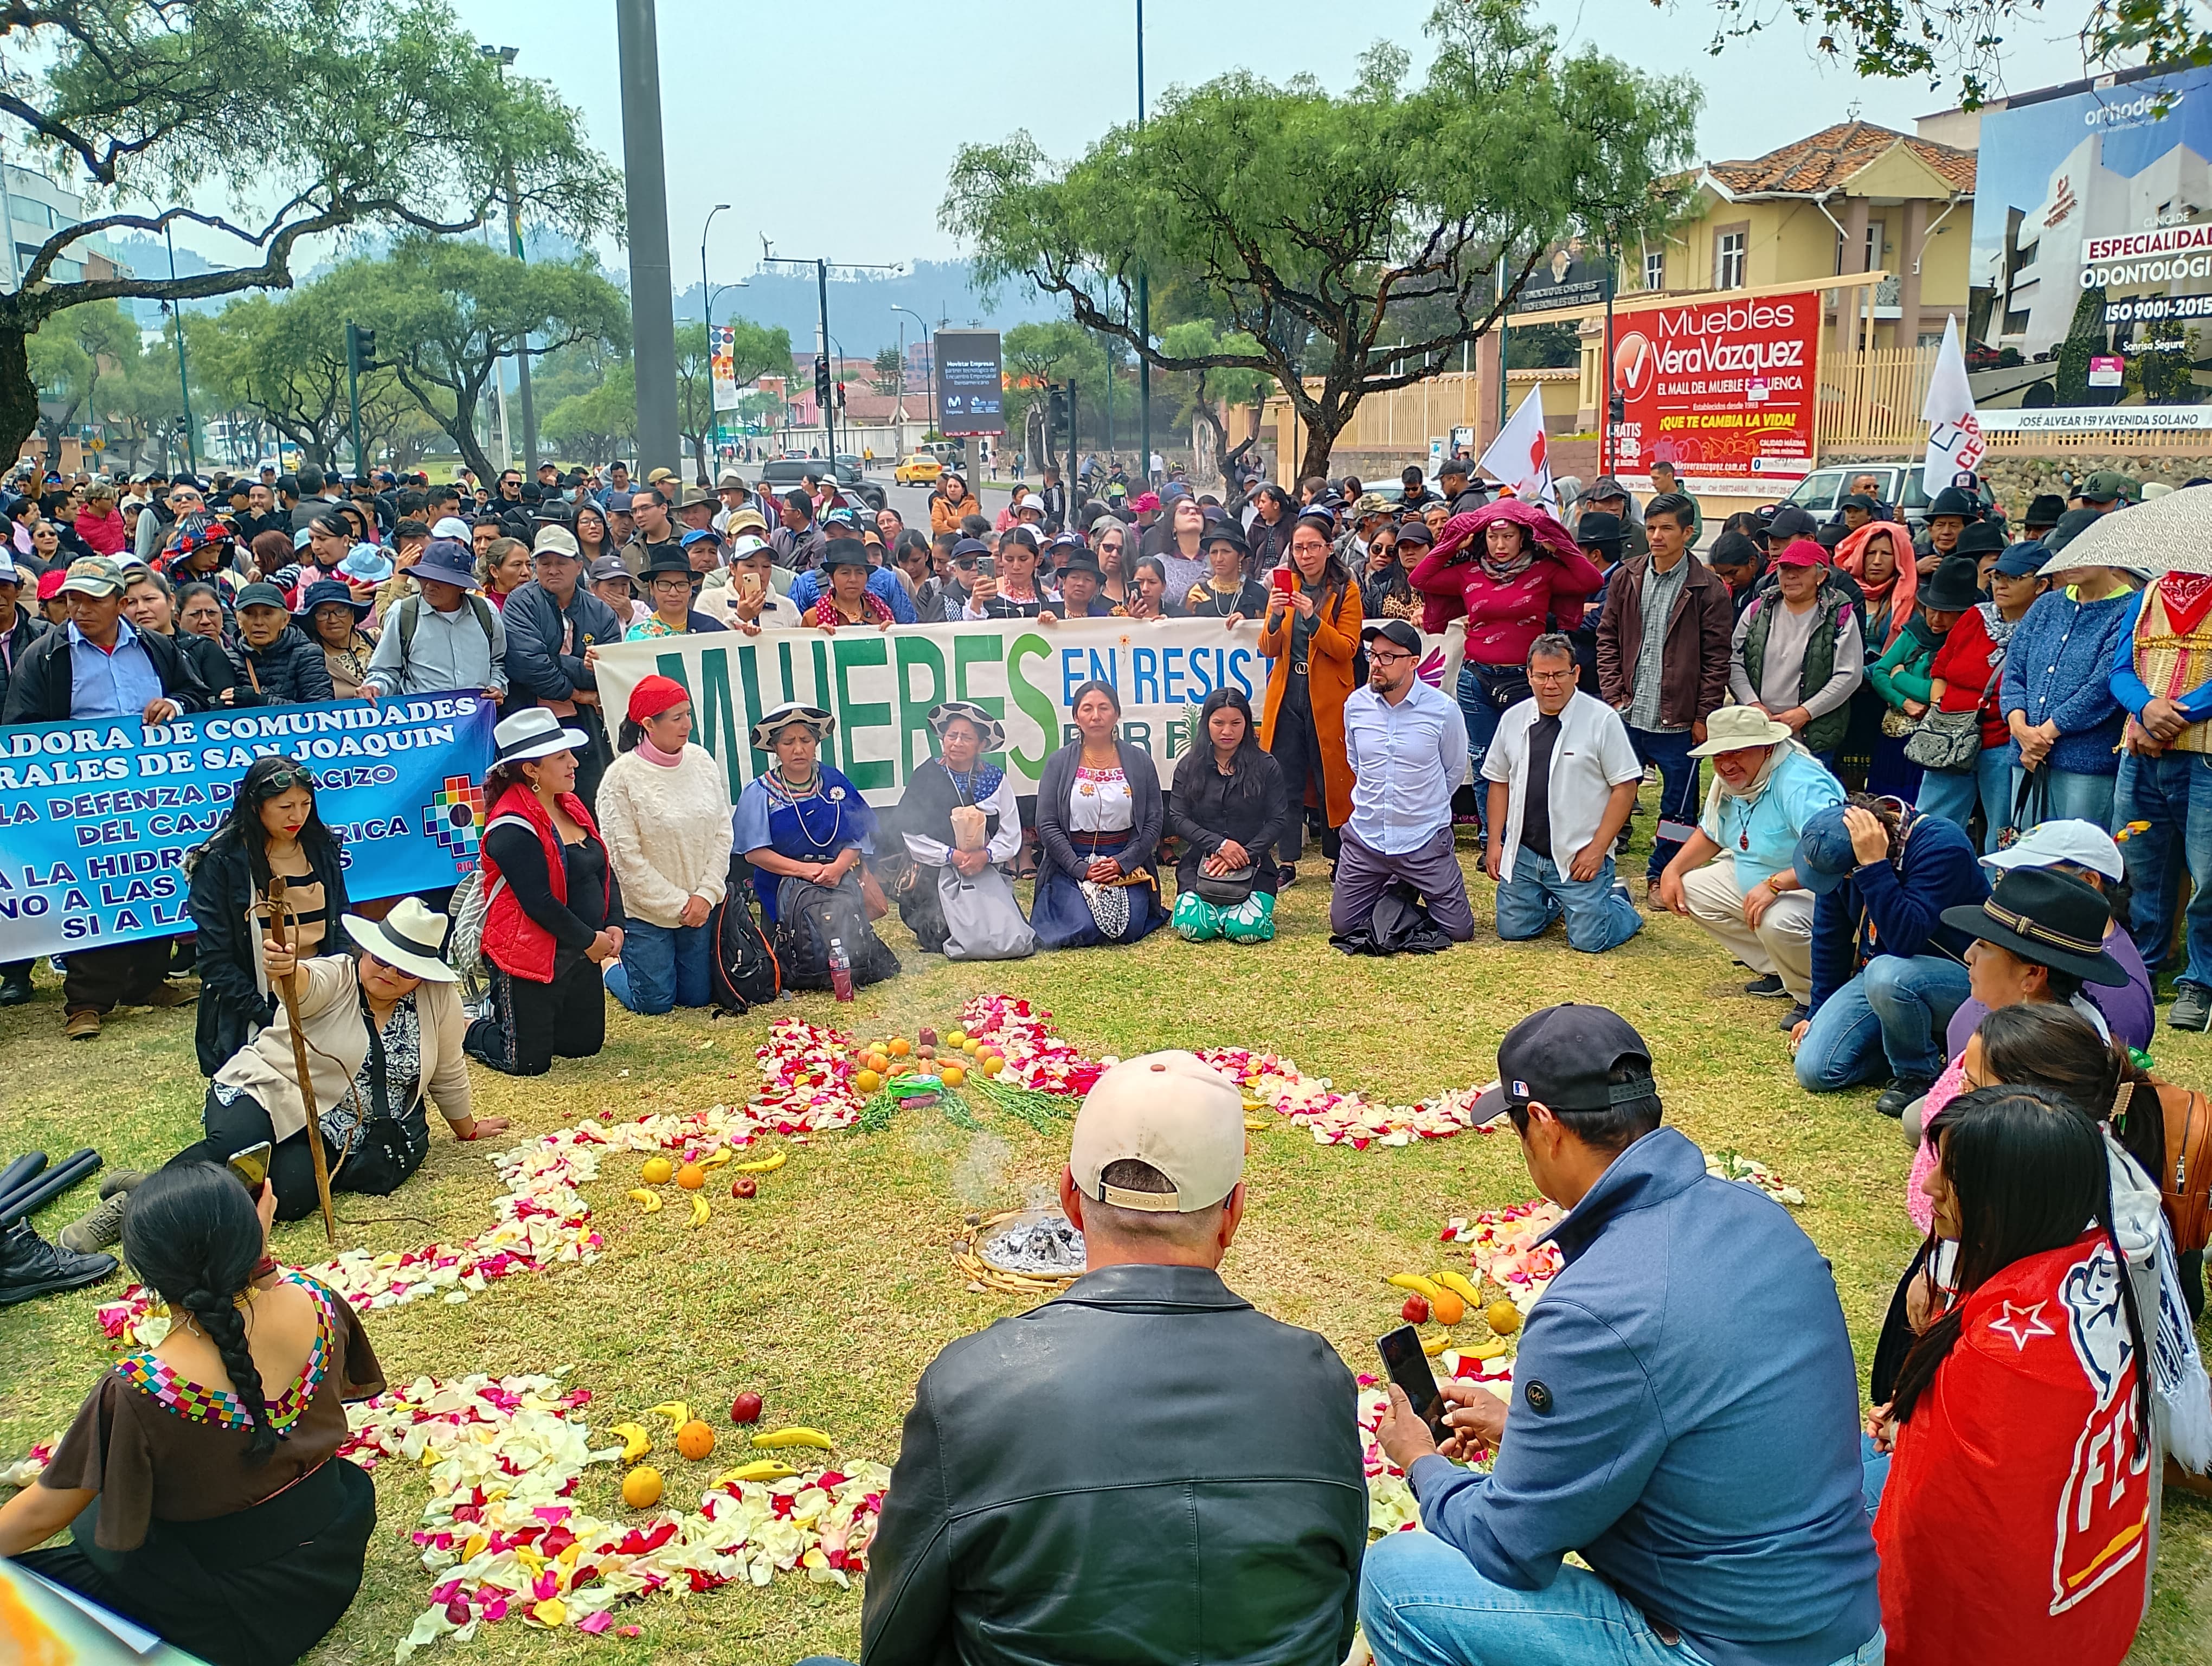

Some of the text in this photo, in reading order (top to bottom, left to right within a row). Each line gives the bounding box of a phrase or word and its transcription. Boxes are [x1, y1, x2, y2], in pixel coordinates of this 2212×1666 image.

[2085, 89, 2173, 125] orthode
[1554, 285, 1564, 296] DE
[1564, 281, 1598, 294] CHOFERES
[1658, 302, 1795, 338] Muebles
[2105, 303, 2132, 322] ISO
[2122, 339, 2185, 352] Sonrisa Segura
[1657, 382, 1667, 396] EL
[1668, 381, 1690, 395] MALL
[1691, 380, 1707, 394] DEL
[1708, 378, 1744, 394] MUEBLE
[1767, 374, 1803, 391] UENCA
[1726, 400, 1744, 410] desde
[1660, 413, 1797, 431] ¡QUE TE CAMBIA LA VIDA!
[2018, 413, 2042, 427] JOSÉ
[2043, 415, 2081, 426] ALVEAR
[2098, 415, 2105, 426] Y
[2105, 414, 2150, 426] AVENIDA
[2151, 414, 2199, 425] SOLANO
[1759, 438, 1784, 447] CALIDAD
[1061, 648, 1118, 706] EN
[142, 722, 198, 747] DE
[205, 696, 478, 741] COMUNIDADES
[137, 751, 196, 777] DE
[290, 725, 455, 762] JOAQUIN
[47, 784, 205, 821] DEFENZA
[74, 818, 140, 848] DEL
[23, 861, 79, 889] LA
[86, 843, 204, 881] HIDR
[455, 860, 474, 874] RIO
[61, 887, 92, 913] A
[99, 874, 177, 907] LAS
[61, 913, 101, 940] SI
[112, 907, 144, 934] A
[1529, 1389, 1544, 1403] MK
